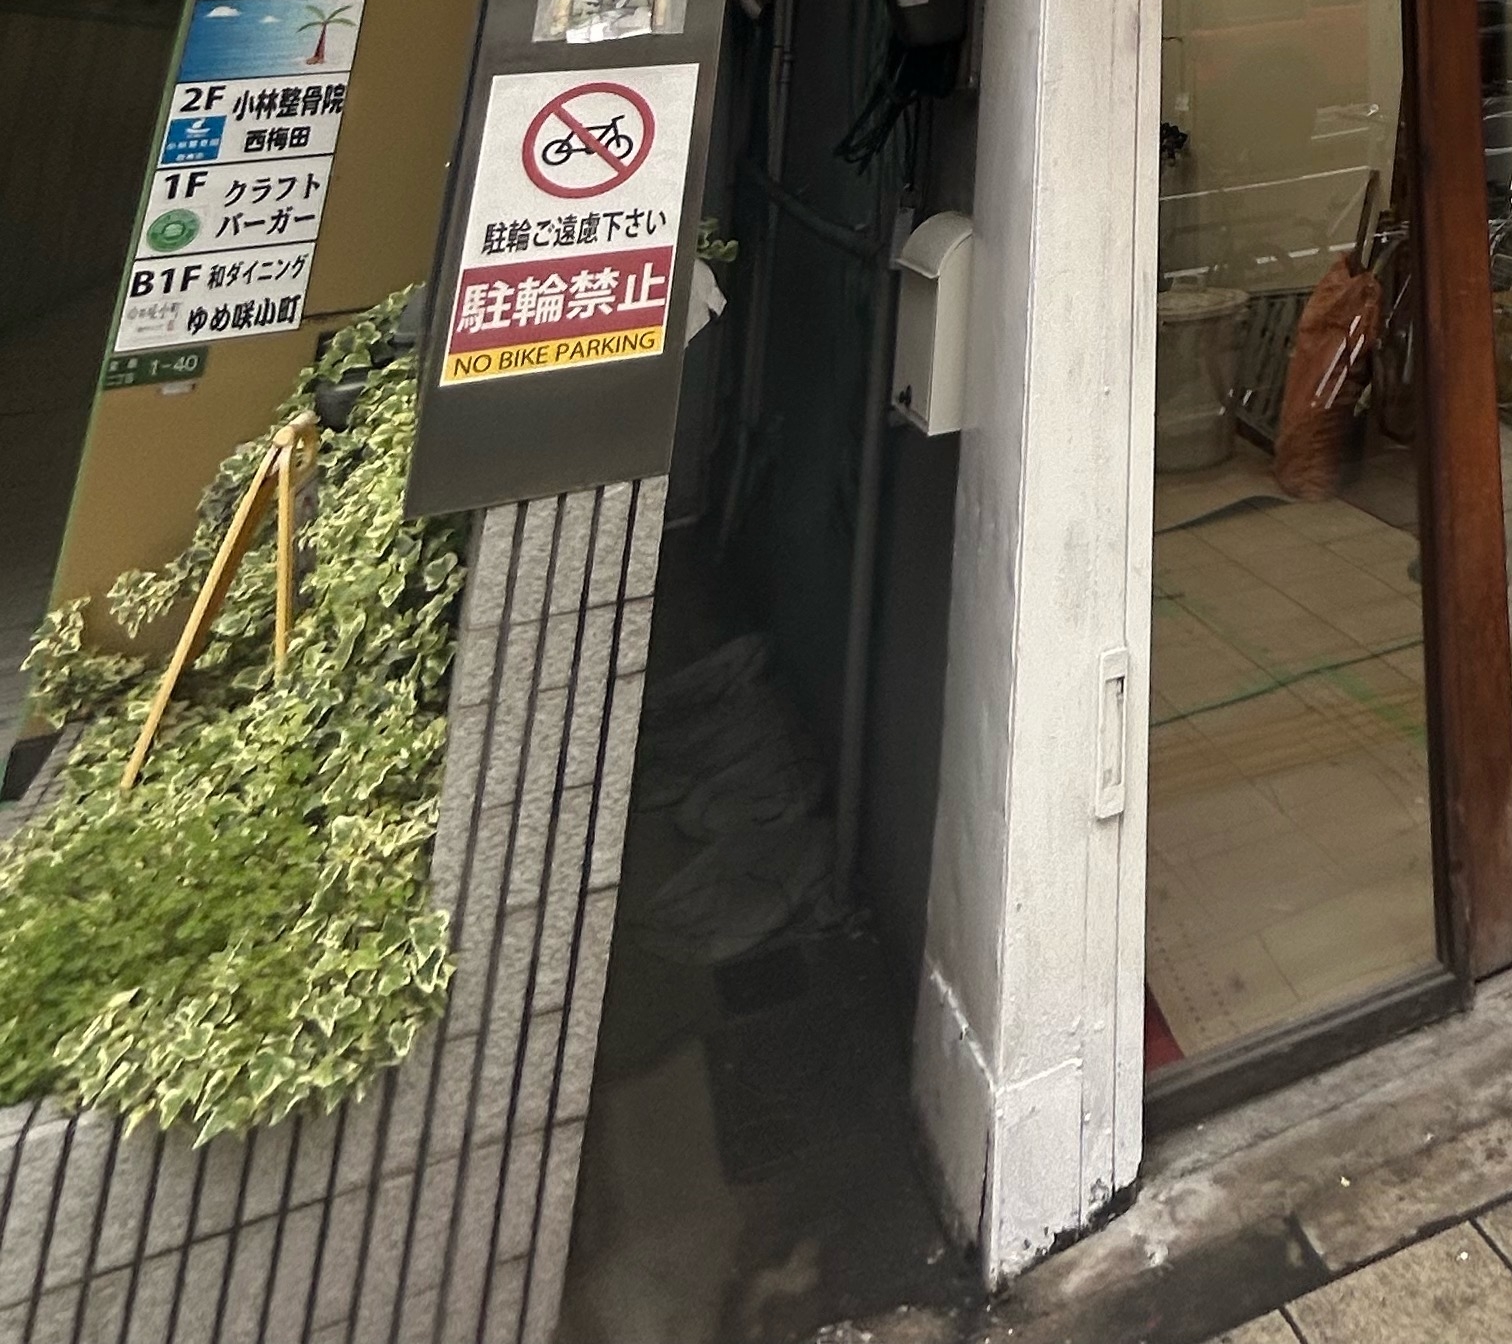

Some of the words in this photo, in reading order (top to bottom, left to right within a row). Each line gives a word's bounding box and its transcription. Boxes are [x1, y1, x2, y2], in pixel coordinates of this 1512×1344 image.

[180, 85, 226, 112] 2F
[232, 84, 347, 121] 小林整骨院
[244, 125, 311, 153] 西梅田
[165, 171, 208, 199] 1F
[224, 173, 320, 207] クラフト
[215, 207, 316, 238] バーガー
[481, 208, 667, 255] 駐輪ご遠慮下さい
[130, 265, 202, 298] B1F
[208, 253, 309, 289] 和ダイニング
[187, 295, 301, 335] ゆめ咲小町
[456, 262, 667, 334] 駐輪禁止
[150, 354, 199, 375] 1-40
[454, 354, 491, 376] NO
[500, 343, 550, 370] BIKE
[556, 330, 656, 361] PARKING
